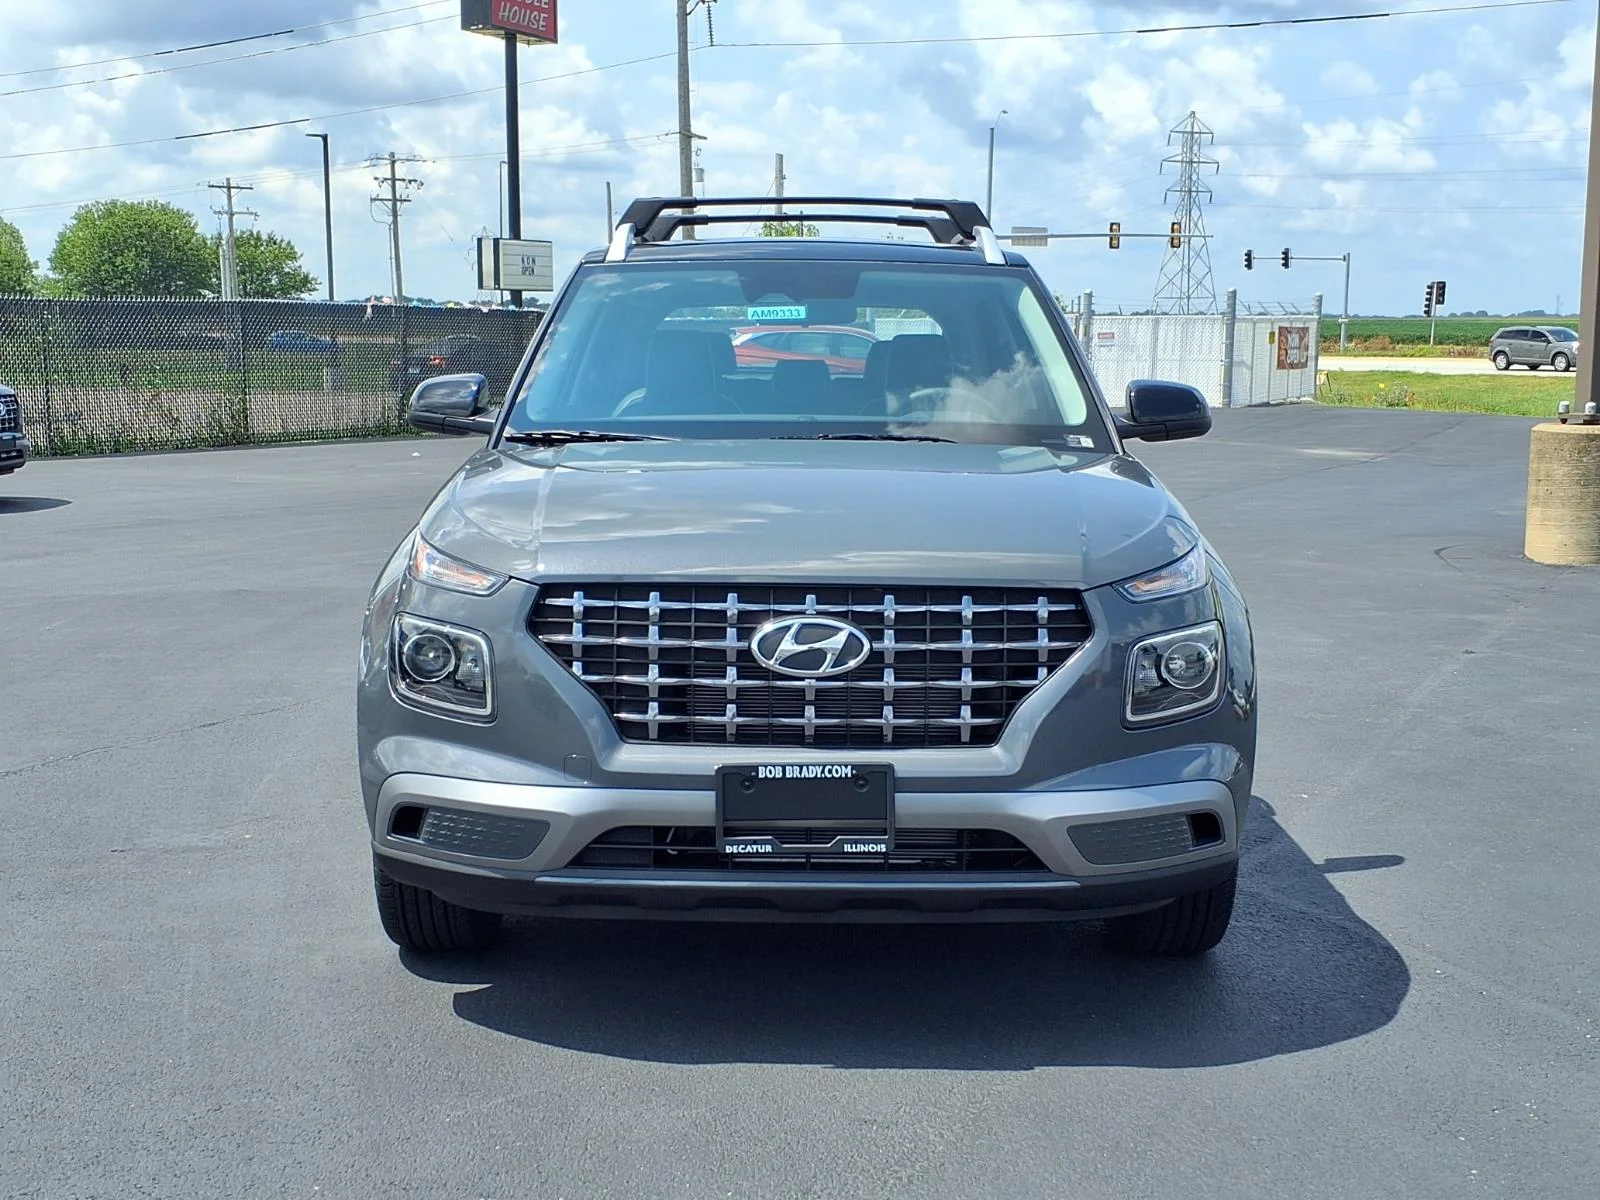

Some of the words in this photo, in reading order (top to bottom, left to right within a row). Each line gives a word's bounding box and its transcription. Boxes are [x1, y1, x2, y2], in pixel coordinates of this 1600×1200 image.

[498, 1, 550, 31] HOUSE
[521, 266, 535, 276] OPEN
[751, 309, 801, 318] AM9333
[758, 765, 782, 778] BOB
[785, 765, 852, 778] BRADY.COM
[725, 844, 773, 853] DECATUR
[843, 843, 887, 852] ILLINOIS
